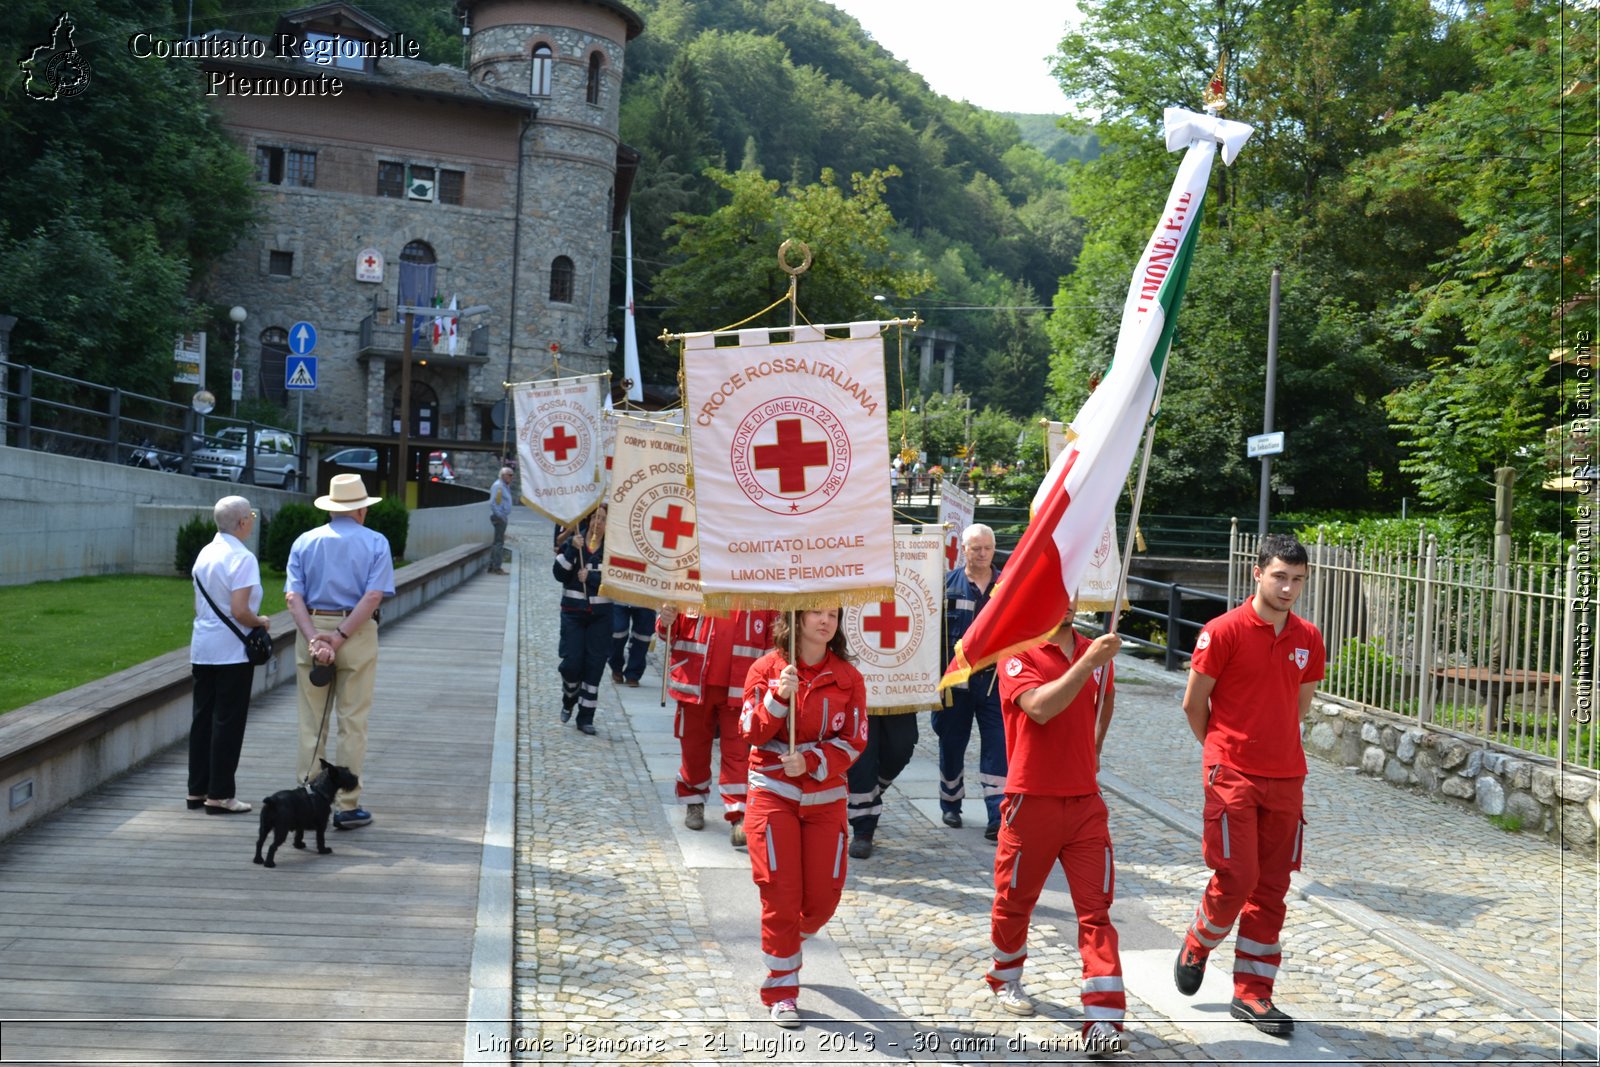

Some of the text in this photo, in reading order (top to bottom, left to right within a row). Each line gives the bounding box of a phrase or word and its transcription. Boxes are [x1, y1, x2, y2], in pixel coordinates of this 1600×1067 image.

[697, 358, 879, 427] CROCE ROSSA ITALIANA
[537, 400, 567, 413] ROSSA
[624, 436, 646, 448] CORPO
[734, 400, 848, 500] CONVENZIONE DI GINEVRA 22 AGOSTO 1864
[535, 483, 597, 498] SAVIGLIANO
[613, 463, 687, 503] CROCE ROSS
[649, 489, 660, 500] DI
[728, 535, 865, 554] COMITATO LOCALE
[791, 554, 802, 564] DI
[900, 552, 928, 560] PIONIERI
[607, 568, 658, 587] COMITATO
[661, 581, 671, 590] DI
[731, 563, 865, 581] LIMONE PIEMONTE
[903, 567, 937, 616] ITALIANA
[888, 672, 919, 682] LOCALE
[921, 672, 930, 680] DI
[885, 684, 936, 695] DALMAZZO
